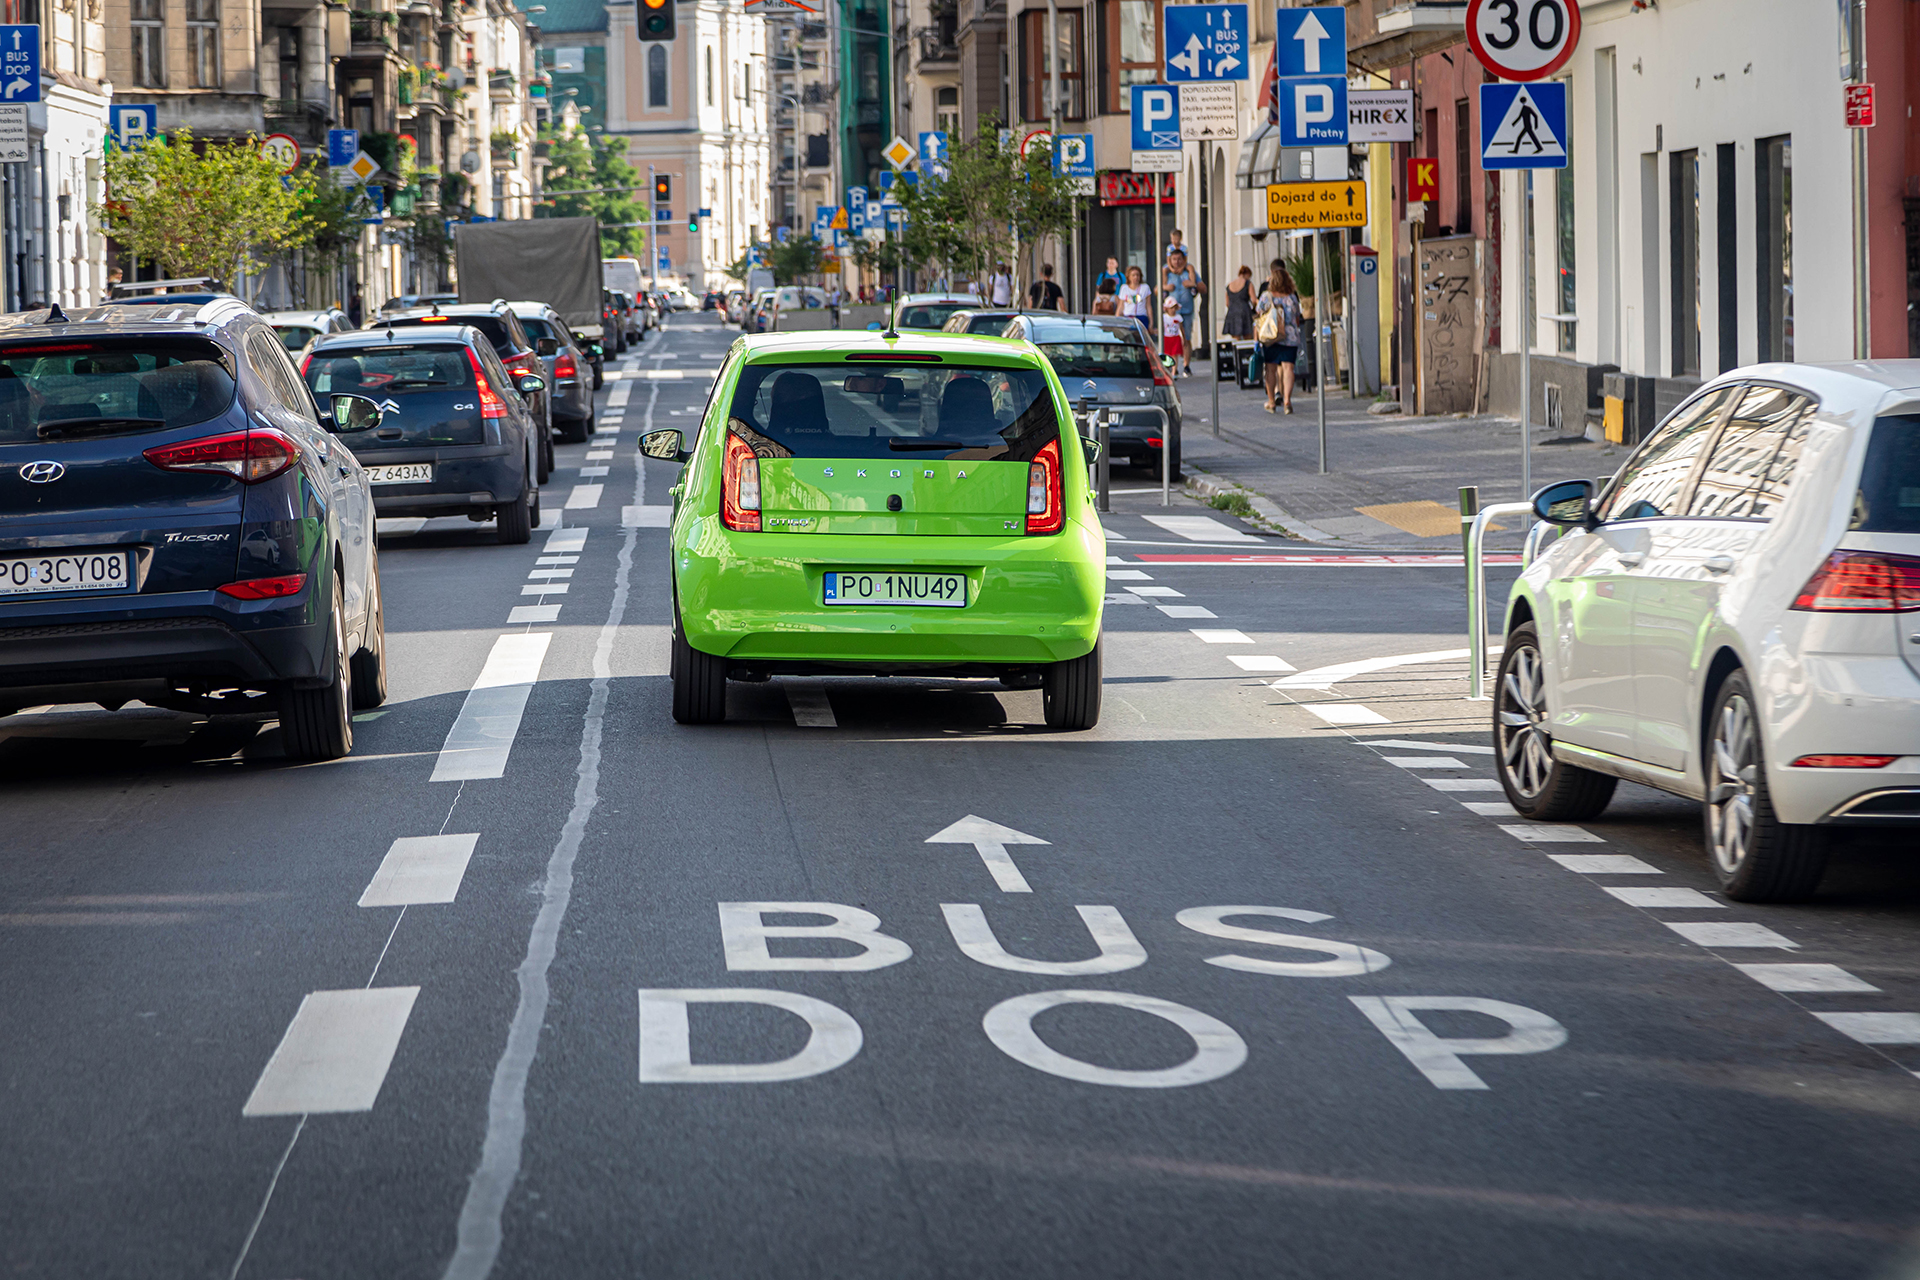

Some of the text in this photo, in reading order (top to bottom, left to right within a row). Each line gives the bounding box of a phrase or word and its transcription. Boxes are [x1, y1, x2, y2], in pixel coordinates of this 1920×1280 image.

[1485, 0, 1564, 50] 30
[1216, 30, 1238, 41] BUS
[1215, 43, 1240, 54] DOP
[6, 52, 29, 62] BUS
[5, 65, 31, 75] DOP
[1143, 90, 1172, 131] P
[1295, 84, 1334, 138] P
[120, 109, 147, 146] P
[1310, 128, 1344, 140] Płatny
[1271, 190, 1336, 205] Dojazd do
[1271, 210, 1363, 226] Urzędu Miasta
[1364, 261, 1374, 273] P
[453, 403, 475, 411] C4
[386, 466, 429, 480] 643AX
[823, 467, 967, 479] ŠKODA
[769, 518, 809, 527] CITIGO
[39, 556, 121, 584] 3CY08
[842, 576, 958, 599] PO 1NU49
[717, 901, 1391, 977] BUS
[639, 987, 1569, 1091] DOP
